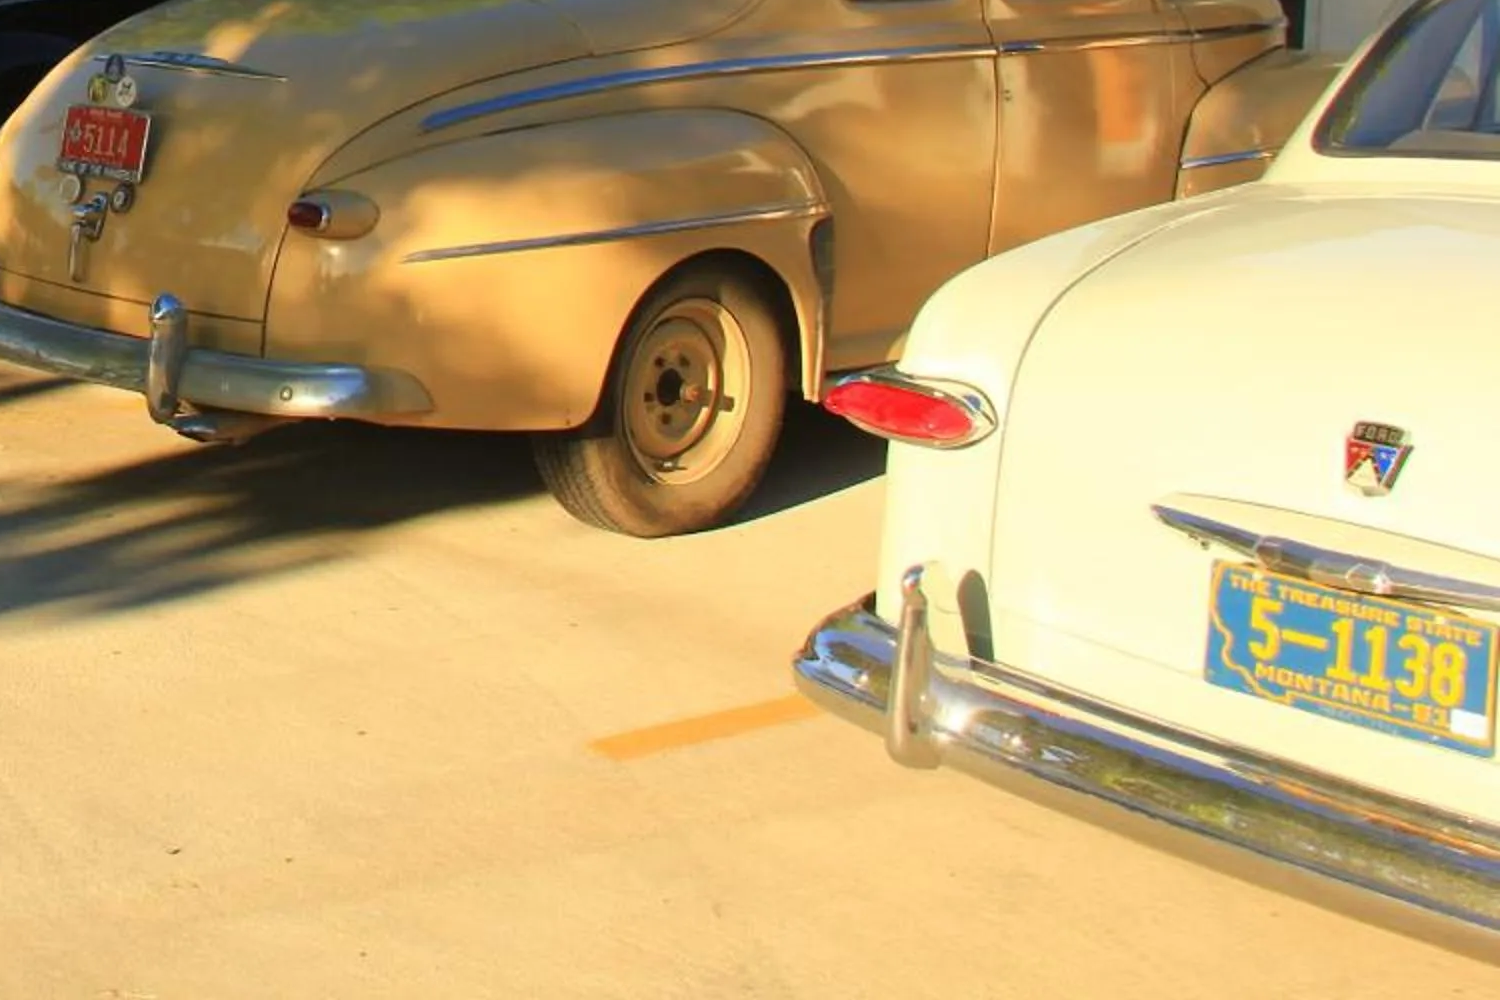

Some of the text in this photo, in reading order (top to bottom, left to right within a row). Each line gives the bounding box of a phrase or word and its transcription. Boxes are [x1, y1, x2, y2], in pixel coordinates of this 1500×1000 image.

[83, 123, 130, 158] 5114
[1354, 424, 1402, 443] FORD
[1229, 572, 1482, 647] THE TREASURE STATE
[1248, 595, 1467, 707] 5-1138
